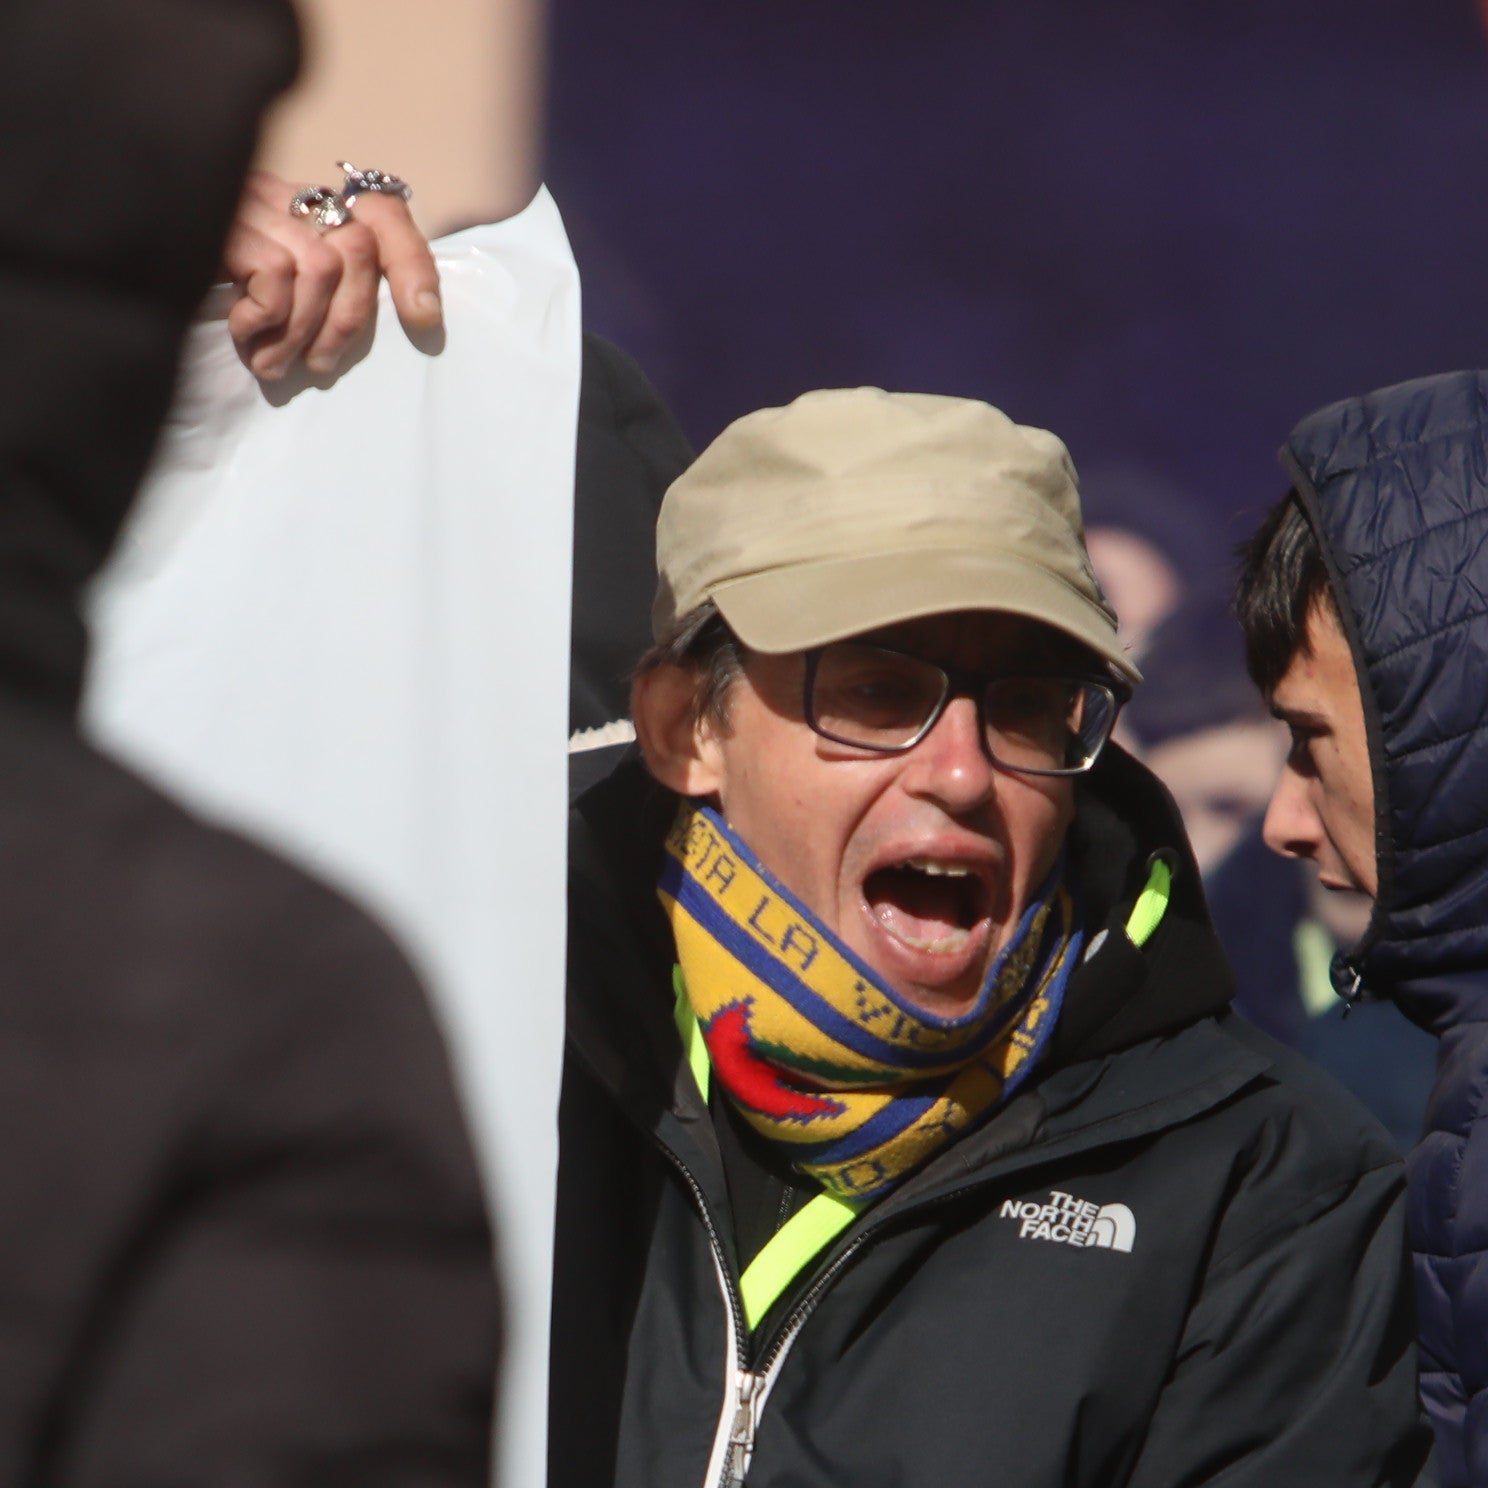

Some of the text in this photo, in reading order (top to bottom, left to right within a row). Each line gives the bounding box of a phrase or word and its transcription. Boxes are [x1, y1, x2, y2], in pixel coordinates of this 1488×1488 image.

[748, 896, 819, 971] LA
[998, 1199, 1097, 1233] NORTH
[1049, 1190, 1100, 1219] THE
[1019, 1219, 1088, 1247] FACE
